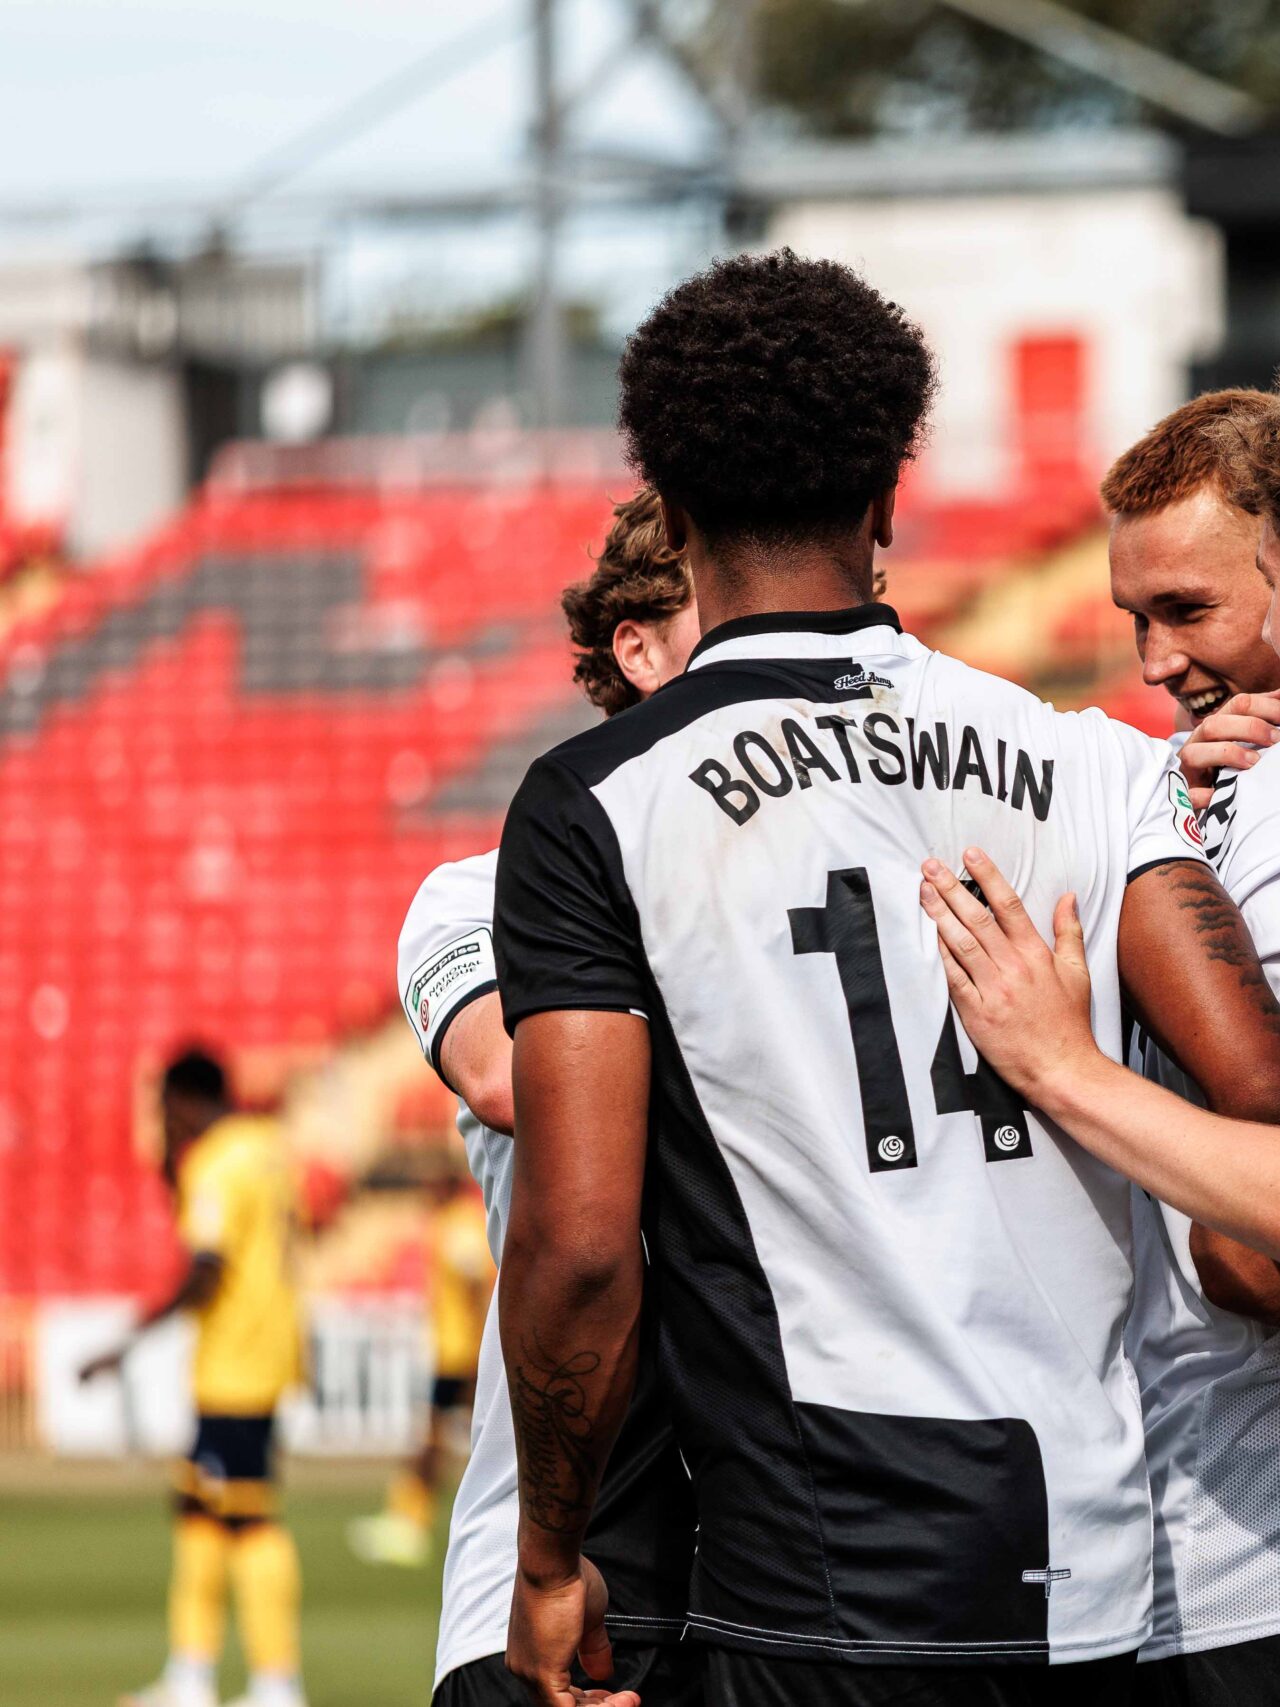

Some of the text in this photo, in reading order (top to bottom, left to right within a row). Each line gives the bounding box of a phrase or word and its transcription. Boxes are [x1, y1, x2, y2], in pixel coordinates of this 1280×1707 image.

[834, 671, 894, 690] Heed Army
[689, 712, 1054, 826] BOATSWAIN
[428, 960, 483, 998] NATIONAL
[435, 967, 477, 998] LEAGUE
[787, 867, 1034, 1173] 14
